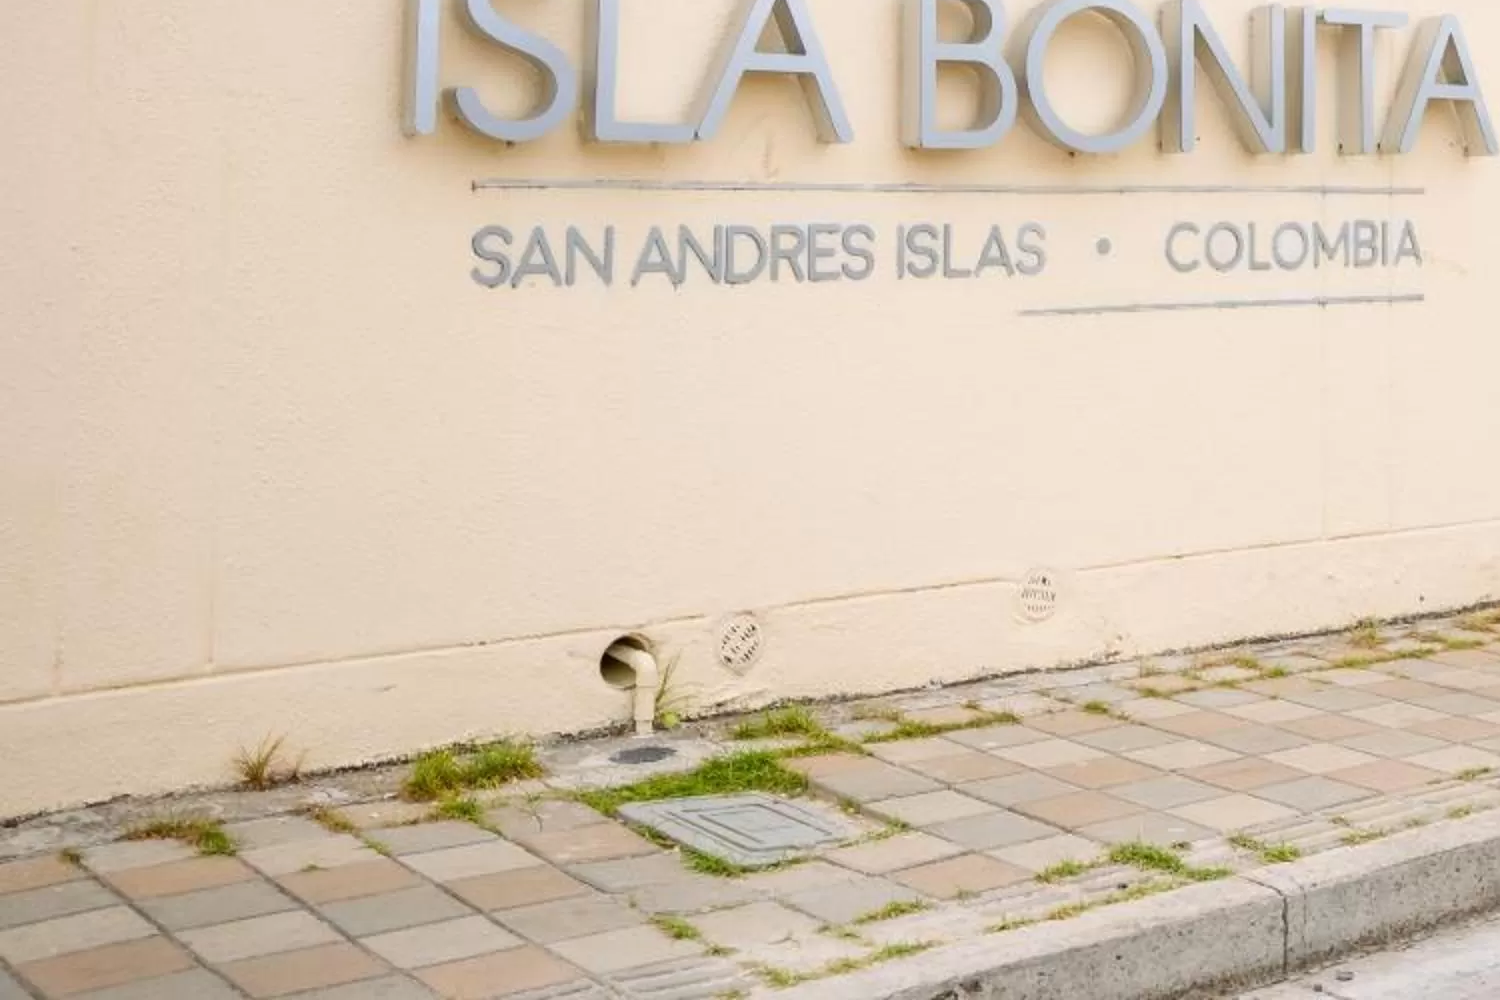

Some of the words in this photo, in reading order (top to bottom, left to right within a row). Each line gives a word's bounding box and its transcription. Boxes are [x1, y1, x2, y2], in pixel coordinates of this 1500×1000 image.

[470, 224, 614, 288] SAN
[630, 223, 875, 288] ANDRES
[896, 221, 1047, 279] ISLAS
[1164, 219, 1423, 273] COLOMBIA
